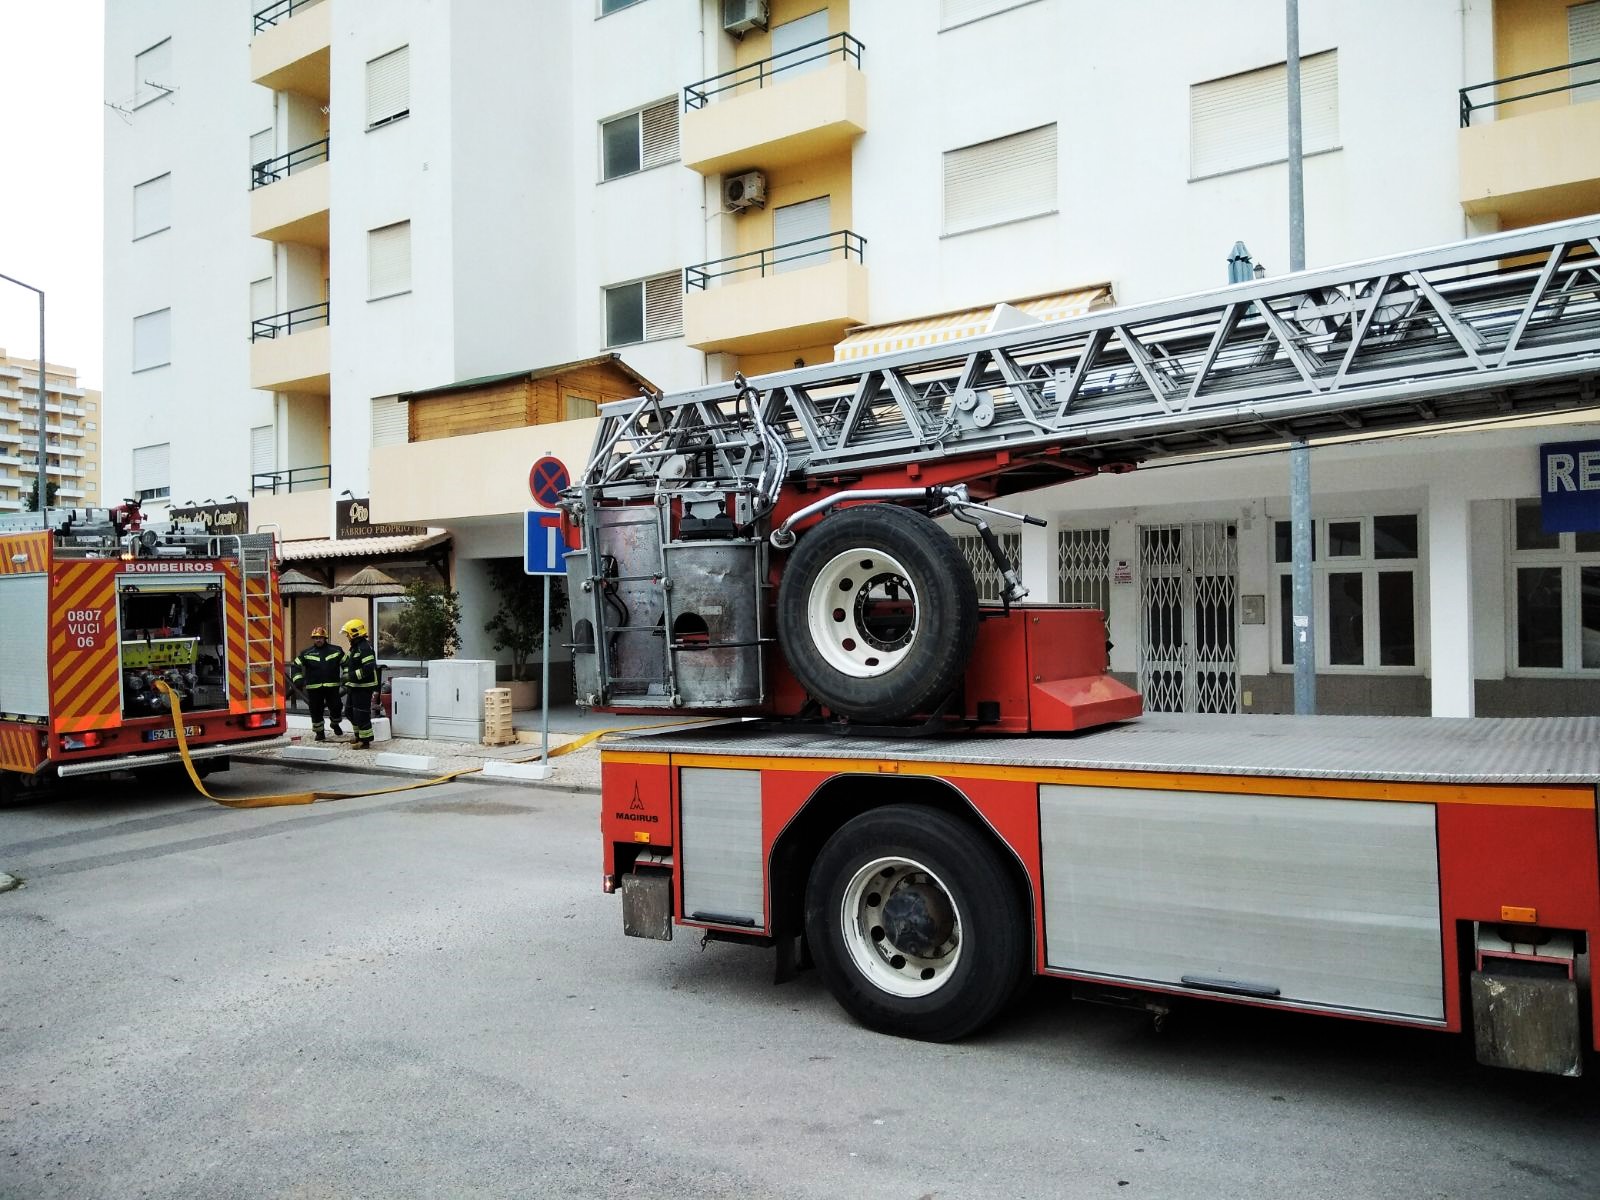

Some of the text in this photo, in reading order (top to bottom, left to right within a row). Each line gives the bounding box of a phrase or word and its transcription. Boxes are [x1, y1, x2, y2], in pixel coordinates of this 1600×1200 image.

[1547, 451, 1600, 493] RE
[125, 562, 214, 572] BOMBEIROS
[67, 610, 101, 622] 0807
[68, 623, 100, 635] VUCI
[77, 636, 95, 648] 06
[615, 812, 659, 823] MAGIRUS
